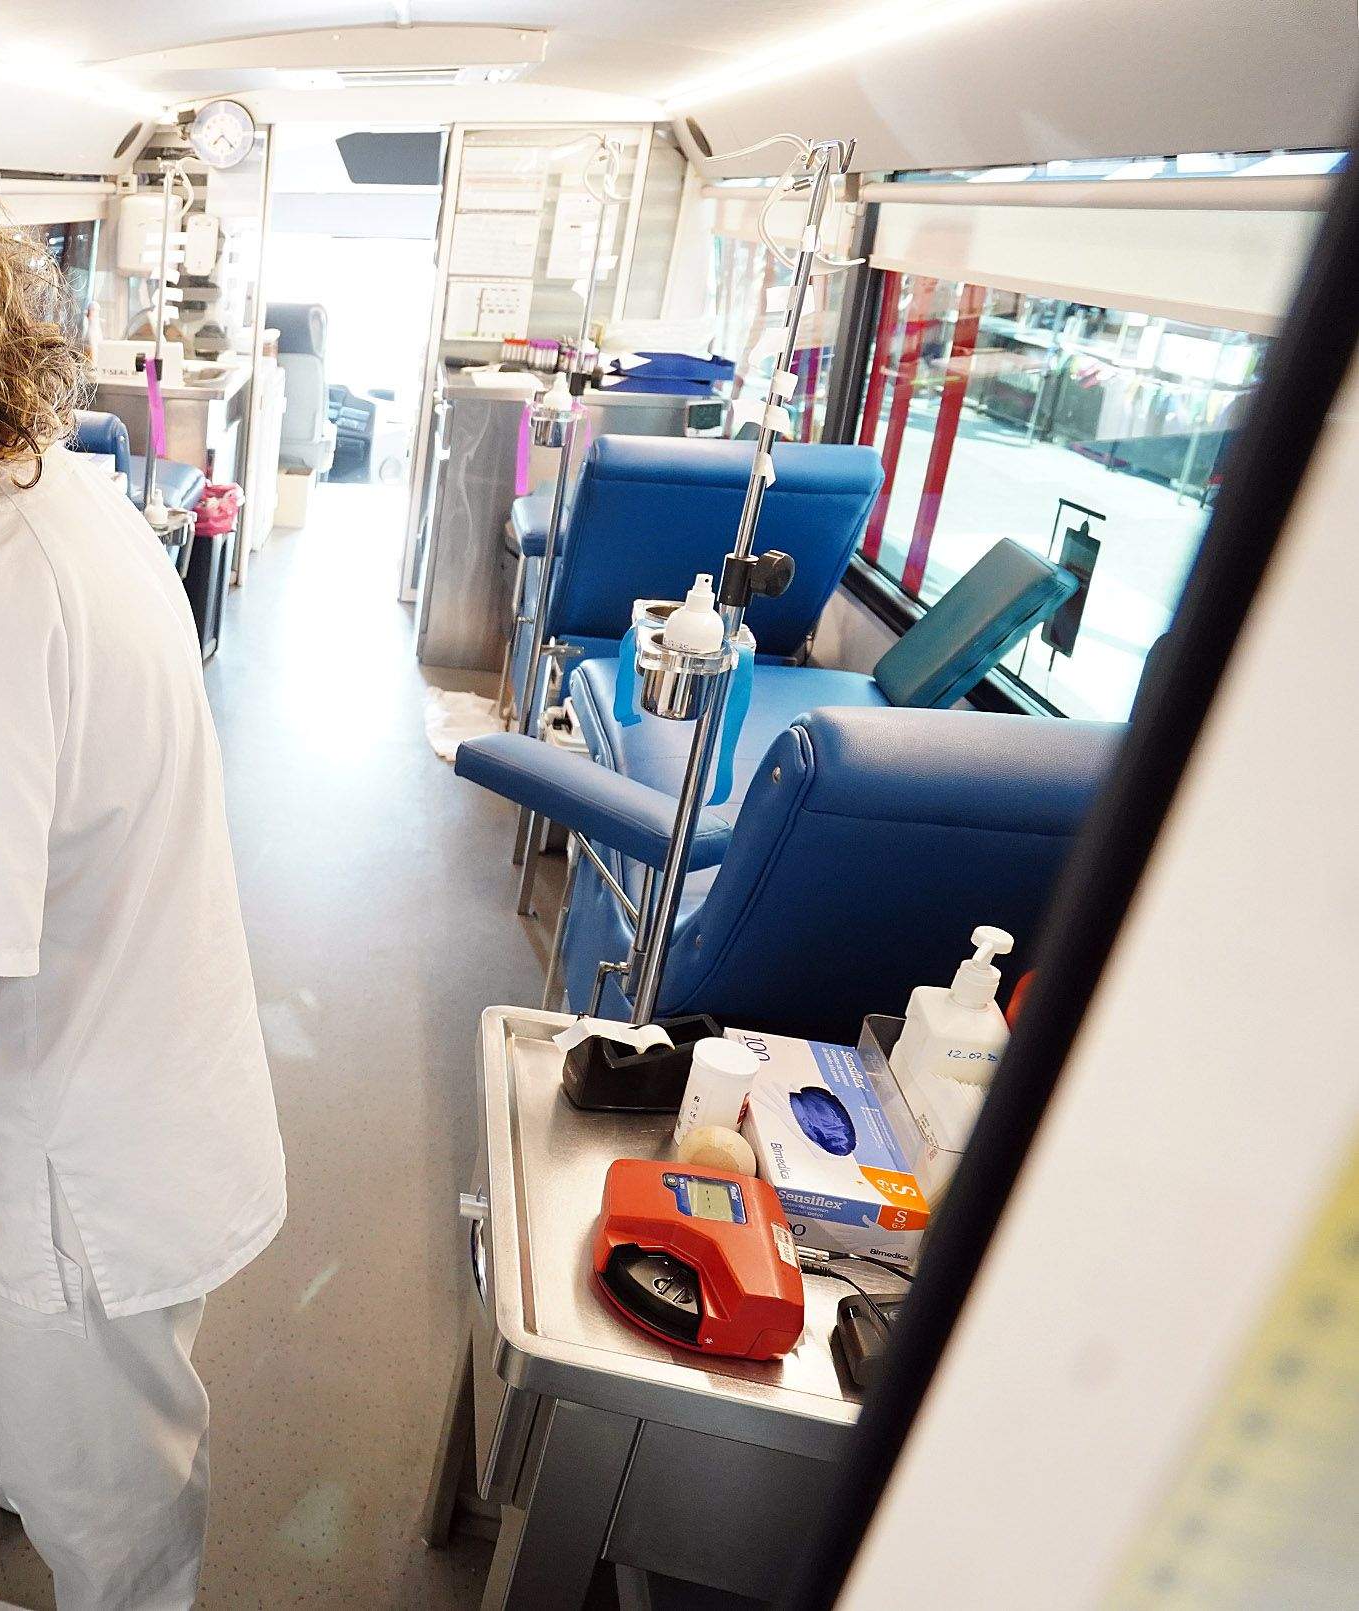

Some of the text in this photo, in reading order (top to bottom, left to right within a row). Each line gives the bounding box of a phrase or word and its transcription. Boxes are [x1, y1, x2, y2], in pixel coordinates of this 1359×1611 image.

[770, 1142, 791, 1180] Bimedica
[892, 1183, 917, 1198] S
[777, 1190, 843, 1211] Sensiflex
[894, 1210, 908, 1224] S
